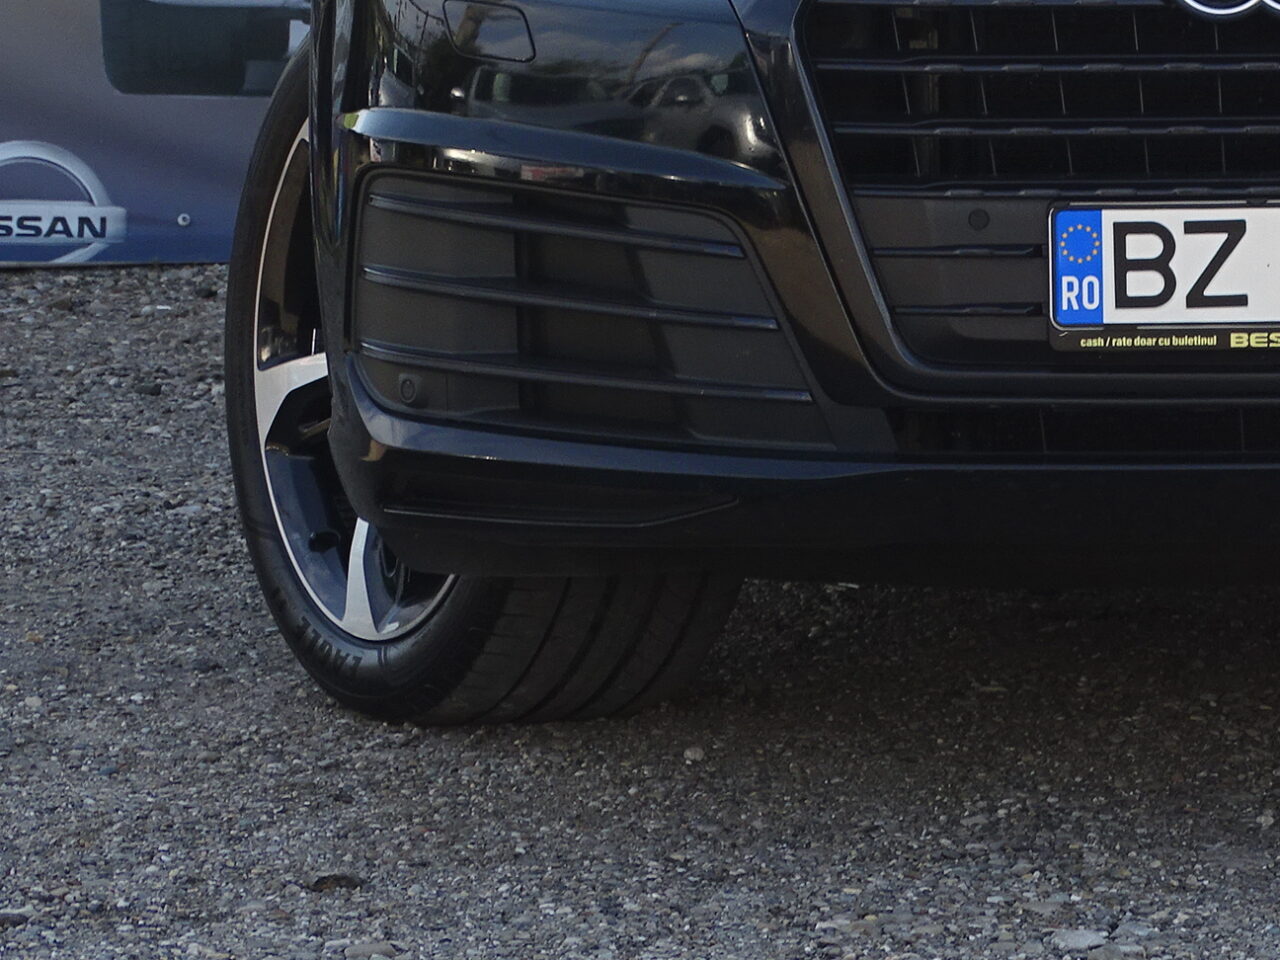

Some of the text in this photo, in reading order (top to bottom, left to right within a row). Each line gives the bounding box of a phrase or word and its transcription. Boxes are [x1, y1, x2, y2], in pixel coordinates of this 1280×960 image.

[1062, 276, 1100, 311] RO
[1112, 219, 1249, 309] BZ
[1080, 335, 1104, 347] cash
[1112, 336, 1132, 347] rate
[1134, 335, 1157, 347] doar
[1158, 337, 1170, 347] cu
[1172, 334, 1217, 347] buletinul
